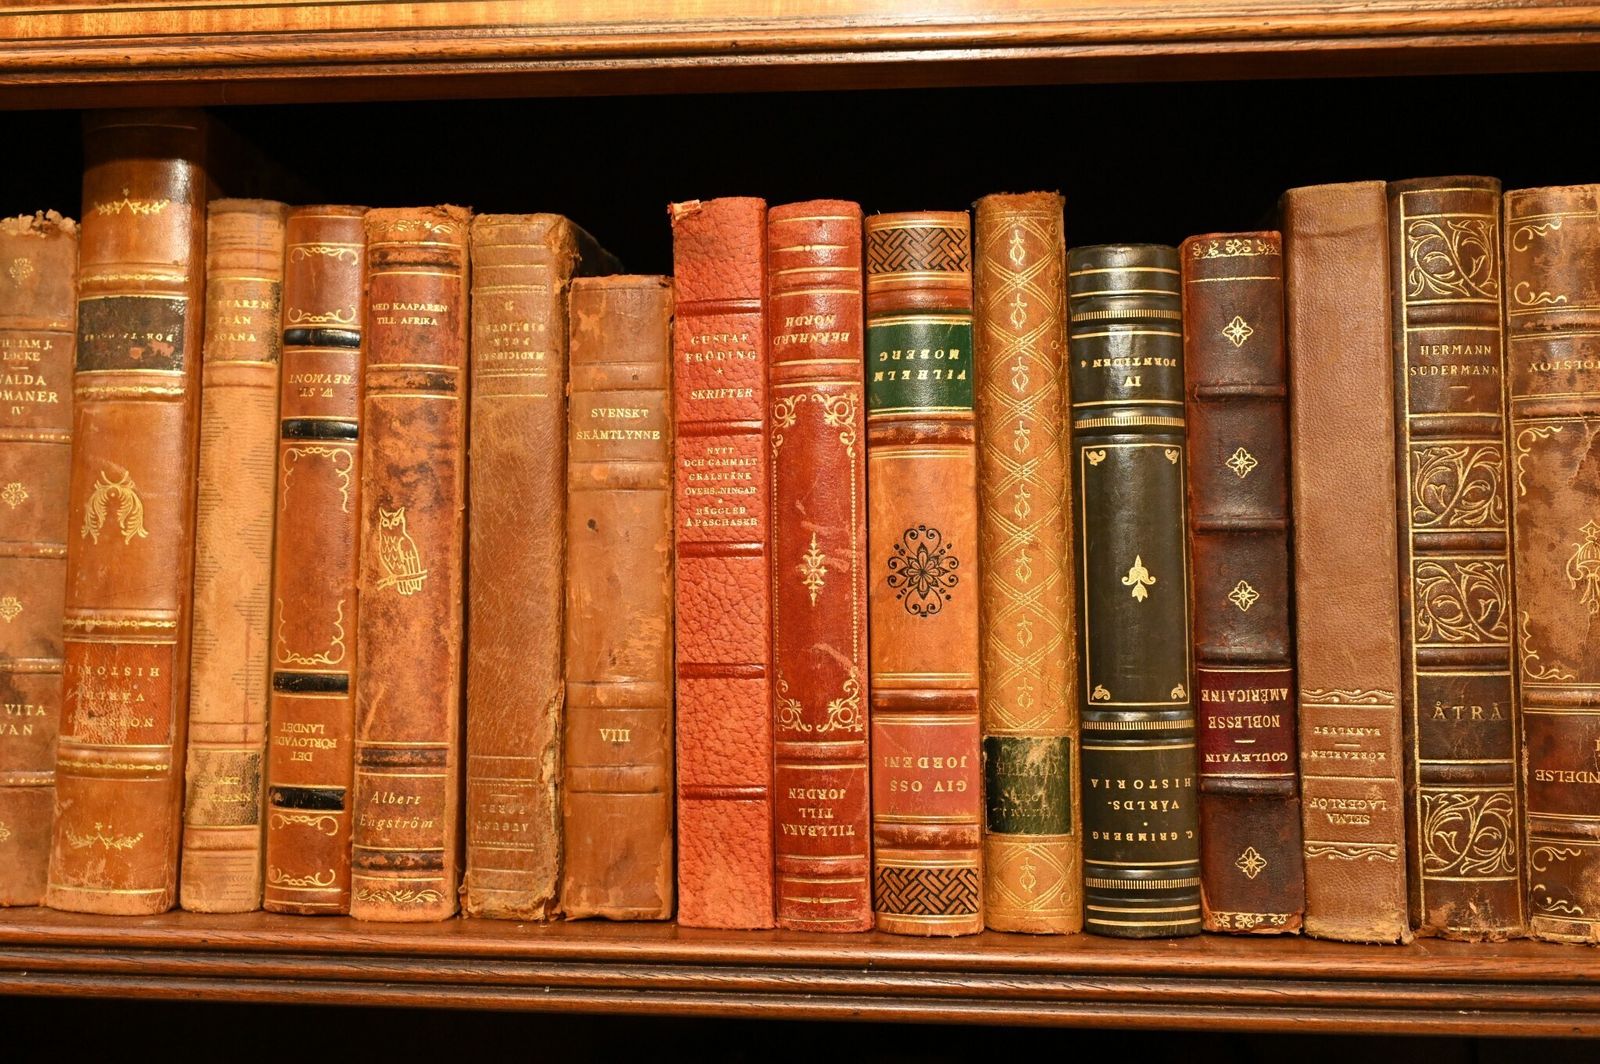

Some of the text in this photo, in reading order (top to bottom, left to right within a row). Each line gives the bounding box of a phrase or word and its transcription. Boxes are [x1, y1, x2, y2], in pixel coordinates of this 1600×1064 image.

[393, 302, 448, 312] KAAPAREN
[377, 316, 438, 326] TILL AFRIKA
[785, 314, 837, 327] NORDH
[690, 332, 749, 345] GUSTAF
[774, 331, 849, 346] BERNHARD
[879, 349, 960, 362] MOBERG
[1420, 344, 1491, 356] HERMANN
[1093, 357, 1176, 368] FORNTIDEN
[874, 369, 966, 382] VILHELM
[1410, 364, 1498, 376] SUDERMANN
[288, 373, 352, 385] REYMONT
[1124, 375, 1142, 387] IV
[0, 390, 59, 403] MANER
[690, 387, 753, 400] SKRIFTER
[591, 408, 649, 419] SVENSKT
[683, 458, 757, 467] OCH GAMMALT
[1201, 687, 1288, 704] AMÉRICAINE
[4, 703, 47, 716] VITA
[1432, 701, 1504, 720] ÅTRÅ
[1208, 715, 1280, 728] NOBLESSE
[280, 722, 325, 735] LANDET
[599, 728, 631, 742] VIII
[1314, 726, 1381, 736] BANNLYST
[290, 751, 313, 762] DET
[1205, 752, 1288, 763] COULEVAIN
[1310, 749, 1386, 762] KÖRKARLEN
[890, 780, 967, 792] GIV OSS
[1091, 777, 1192, 790] HISTORIA
[371, 791, 421, 805] Albert
[788, 787, 847, 800] JORDEN
[1107, 799, 1179, 813] VÄRLDS-
[1310, 797, 1387, 811] LAGERLÖF
[798, 807, 834, 819] TILL
[1327, 813, 1370, 825] SELMA
[360, 814, 433, 832] Engström
[782, 824, 855, 837] TILLBAKA
[1092, 830, 1178, 842] GRIMBERG
